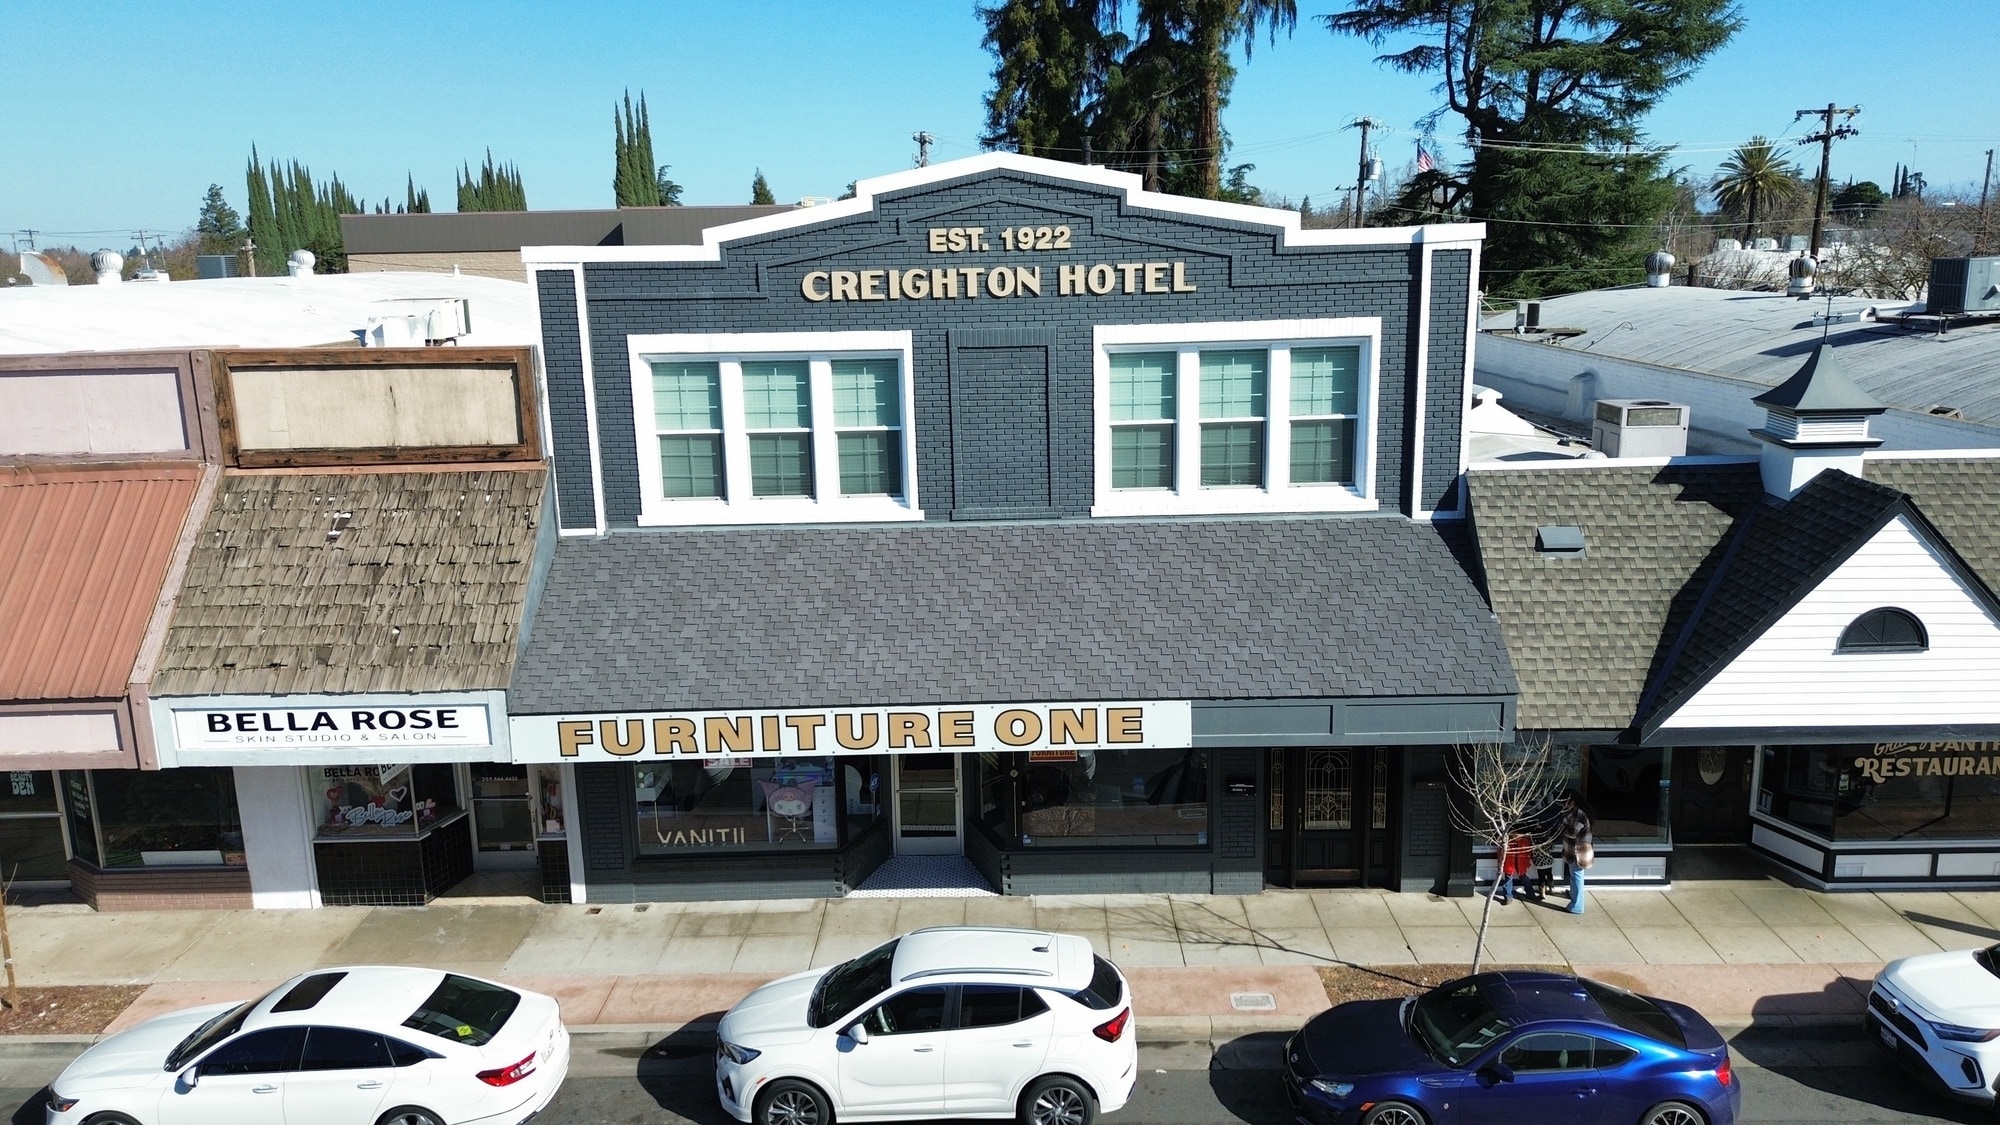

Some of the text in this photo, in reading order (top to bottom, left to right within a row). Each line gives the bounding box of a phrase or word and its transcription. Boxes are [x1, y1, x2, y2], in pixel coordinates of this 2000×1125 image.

[929, 225, 1072, 252] EST. 1922
[801, 261, 1197, 301] CREIGHTON HOTEL
[207, 709, 460, 733] BELLA ROSE
[557, 706, 1144, 757] FURNITURE ONE
[235, 732, 438, 743] SKIN STUDIO & SALON
[323, 767, 362, 778] BELLA
[11, 781, 35, 795] DEN
